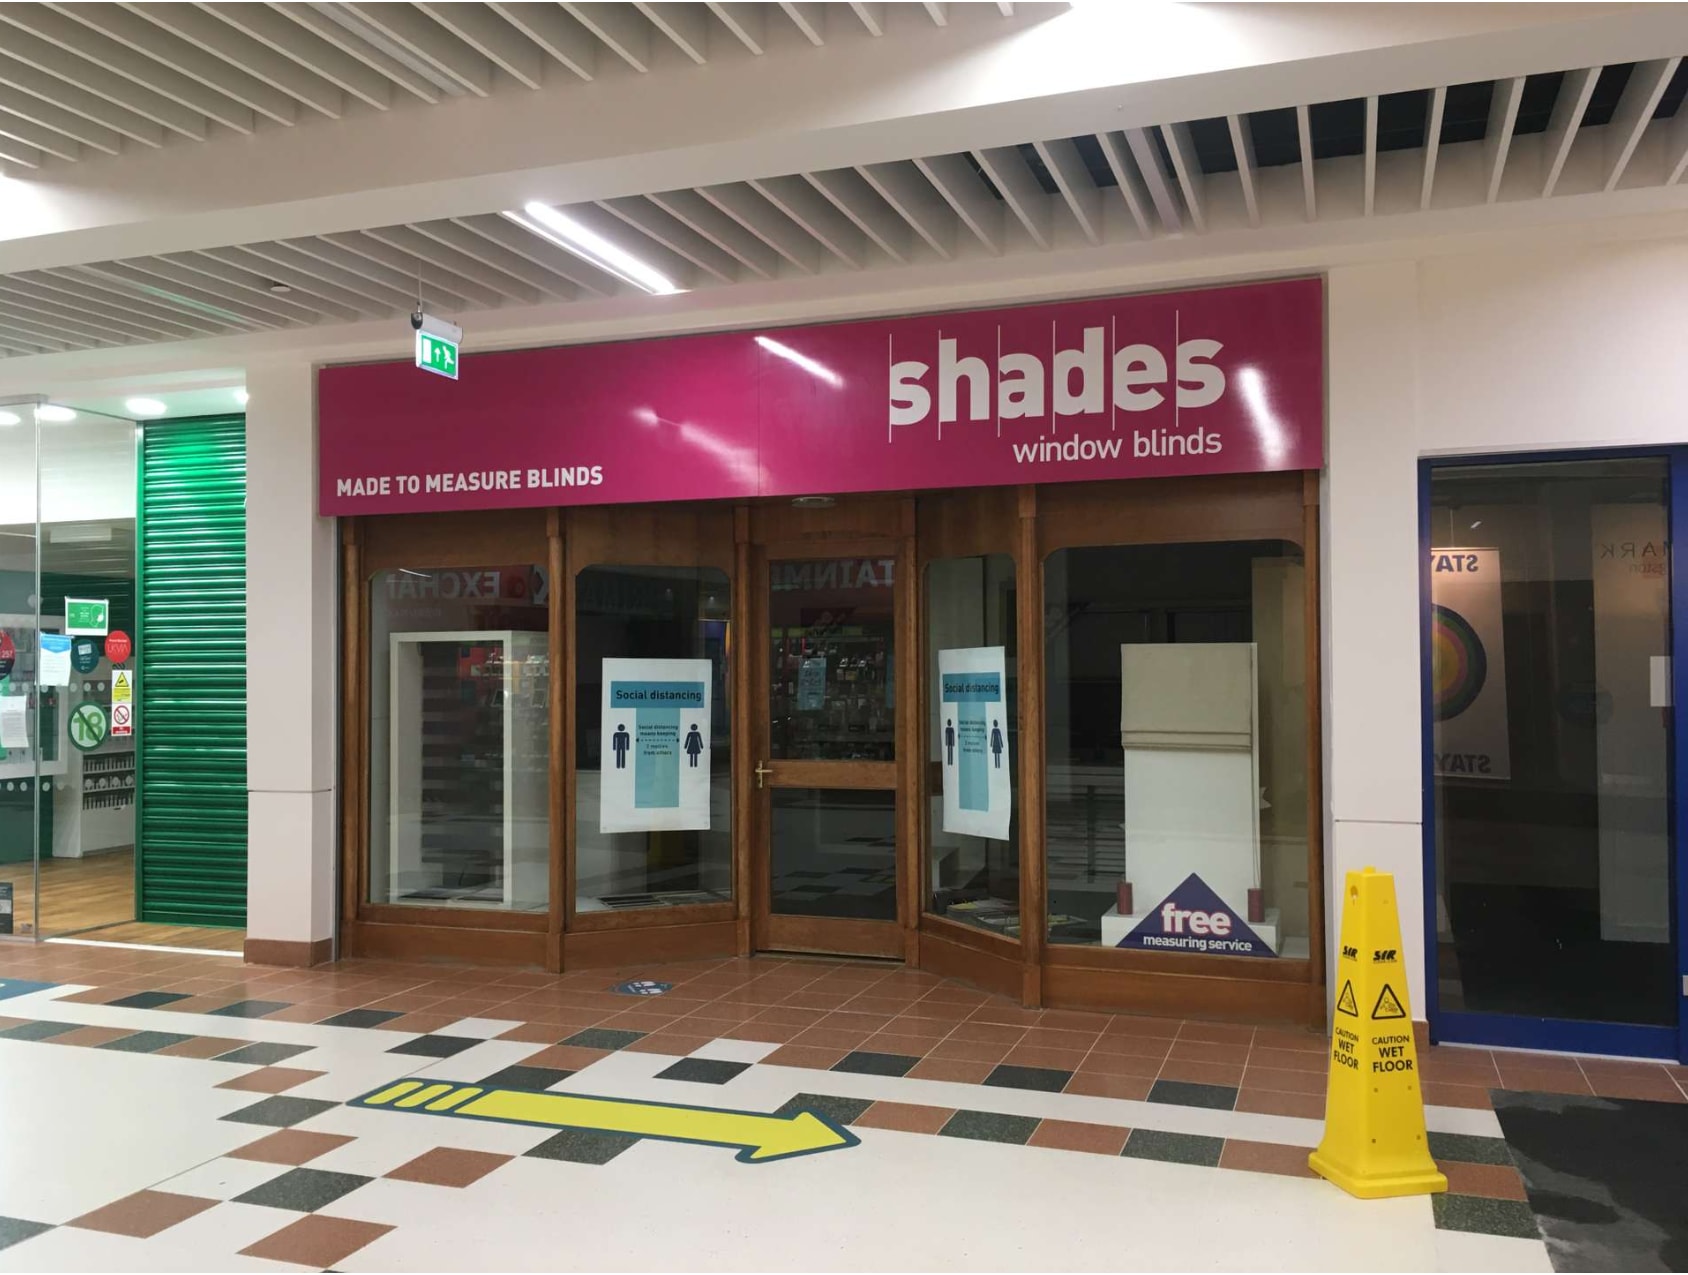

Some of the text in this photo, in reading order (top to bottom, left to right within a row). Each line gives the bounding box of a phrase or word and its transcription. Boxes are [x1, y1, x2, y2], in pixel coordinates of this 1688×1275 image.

[889, 322, 1227, 427] shades
[1012, 427, 1223, 463] window blinds
[336, 466, 603, 497] MADE TO MEASURE BLINDS
[616, 690, 702, 701] Social distancing
[945, 683, 999, 694] Social distancing
[73, 712, 103, 740] 18
[1161, 902, 1232, 935] free
[1143, 935, 1253, 951] measuring service
[1342, 945, 1358, 958] SIR
[1373, 950, 1397, 961] SIR
[1335, 1026, 1359, 1042] CAUTION
[1372, 1035, 1410, 1045] CAUTION
[1338, 1038, 1355, 1054] WET
[1378, 1046, 1405, 1058] WET
[1333, 1050, 1359, 1070] FLOOR
[1372, 1059, 1414, 1073] FLOOR
